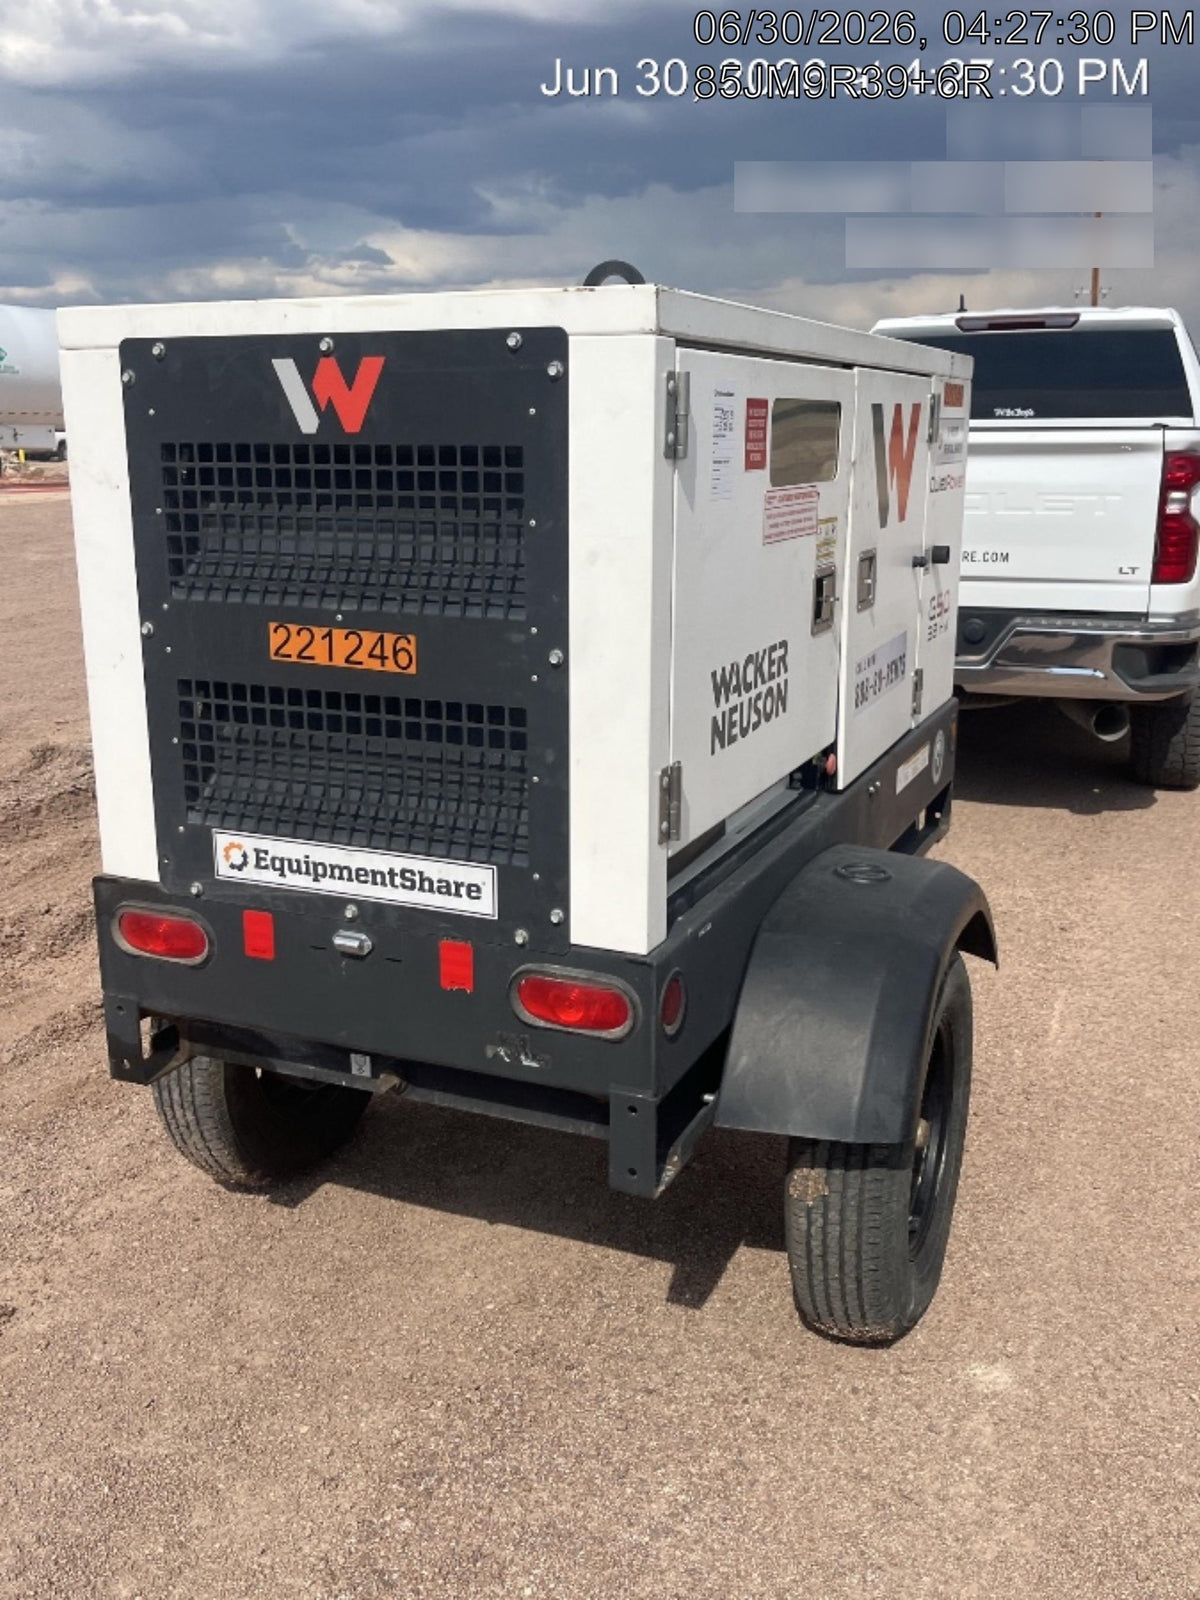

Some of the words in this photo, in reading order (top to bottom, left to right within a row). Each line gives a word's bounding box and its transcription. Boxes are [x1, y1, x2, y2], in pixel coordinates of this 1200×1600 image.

[961, 550, 1010, 563] RE.COM
[1118, 566, 1141, 575] LT
[273, 624, 413, 671] 221246
[710, 639, 789, 709] WACKER
[710, 678, 788, 756] NEUSON
[253, 847, 483, 901] EquipmentShare
